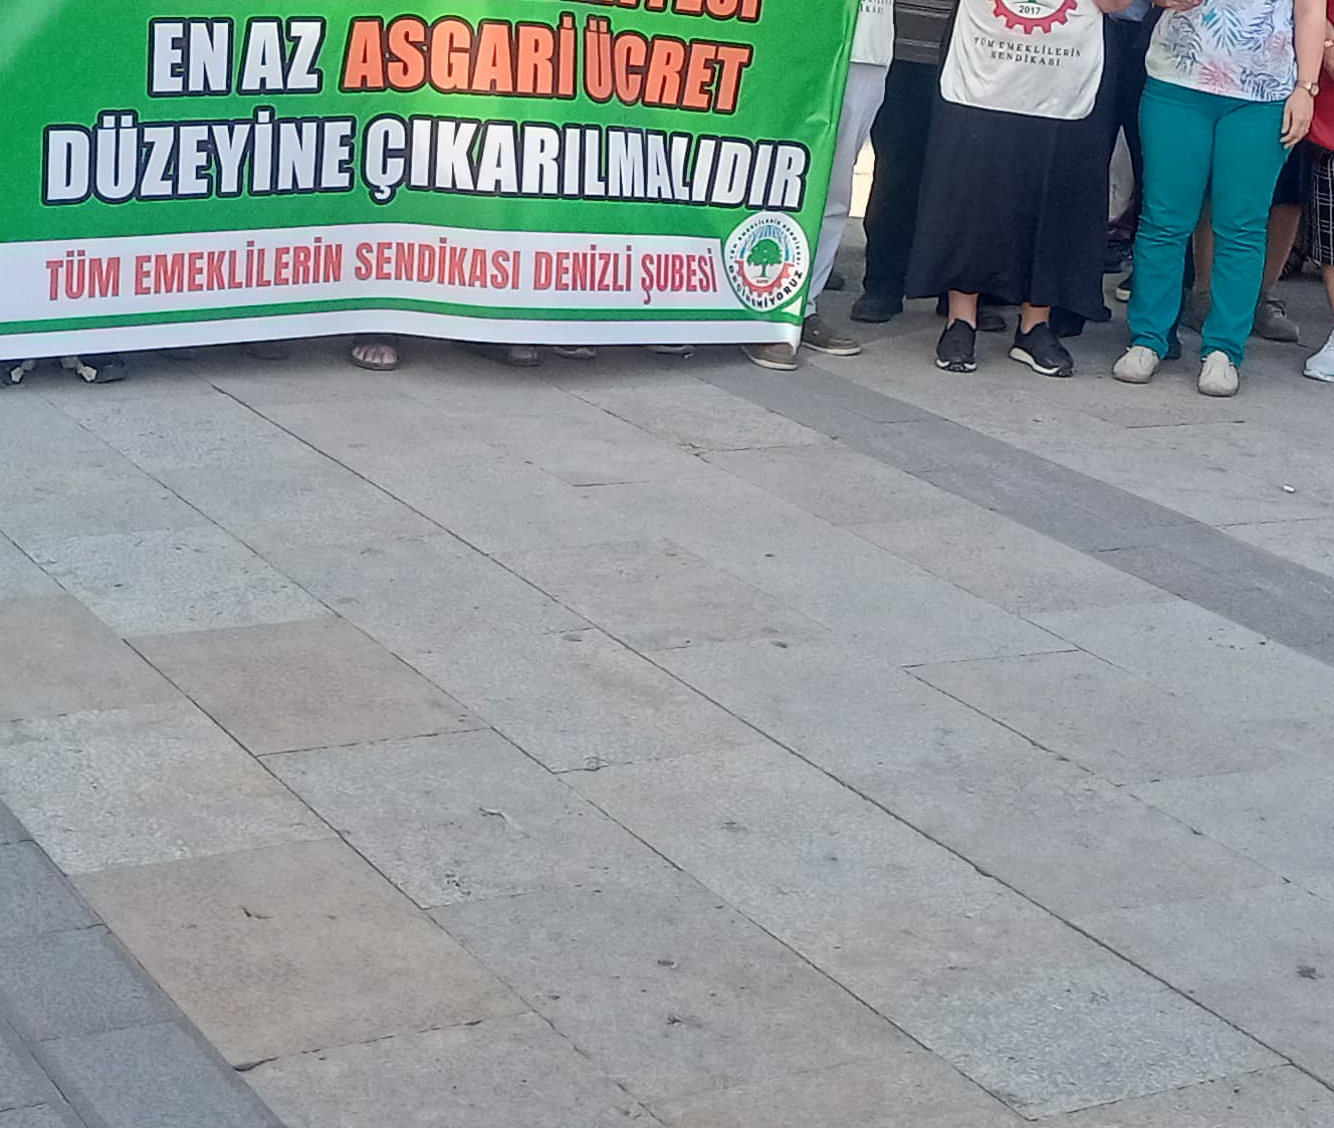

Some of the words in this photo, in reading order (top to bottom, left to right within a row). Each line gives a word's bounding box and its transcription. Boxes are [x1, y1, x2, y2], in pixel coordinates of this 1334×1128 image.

[1019, 5, 1041, 15] 2017
[151, 21, 229, 93] EN
[241, 20, 323, 92] AZ
[342, 15, 575, 96] ASGARİ
[584, 18, 750, 111] ÜCRET
[44, 111, 353, 203] DÜZEYİNE
[366, 119, 807, 209] ÇIKARILMALIDIR
[46, 250, 120, 301] TÜM
[134, 237, 342, 295] EMEKLİLERİN
[355, 237, 520, 290] SENDİKASI
[533, 244, 632, 292] DENİZLİ
[641, 248, 718, 305] ŞUBESİ
